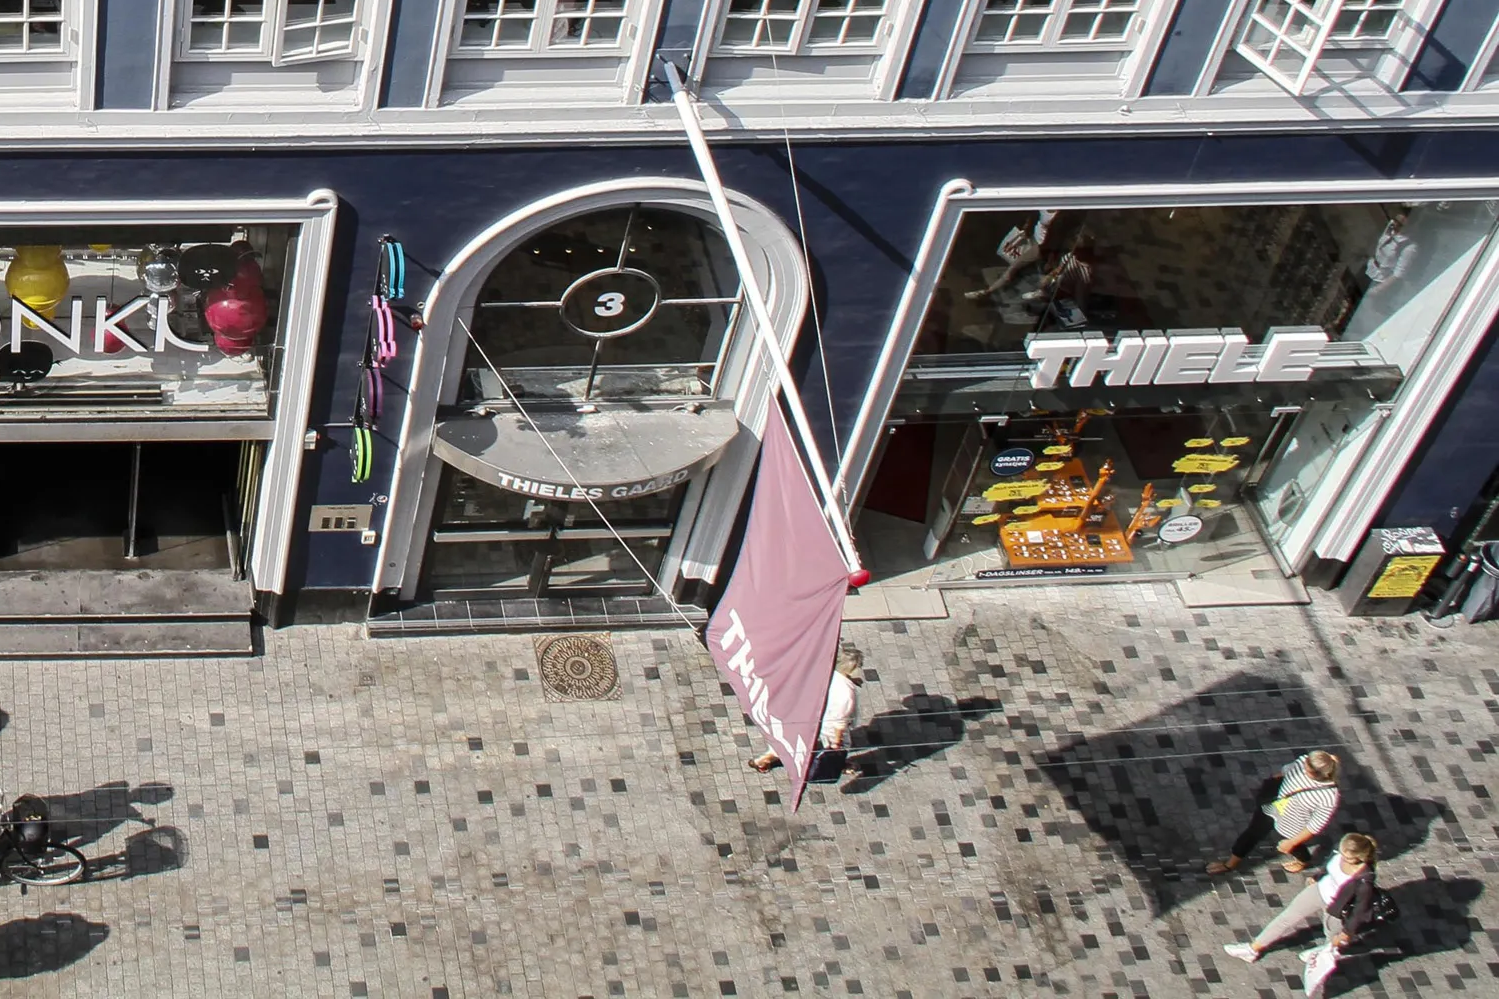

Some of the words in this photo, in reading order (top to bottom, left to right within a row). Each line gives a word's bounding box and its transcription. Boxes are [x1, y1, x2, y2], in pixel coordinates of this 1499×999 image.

[594, 292, 626, 317] 3
[1025, 327, 1329, 388] THIELE
[498, 472, 604, 499] THIELES
[611, 469, 689, 498] GAARD
